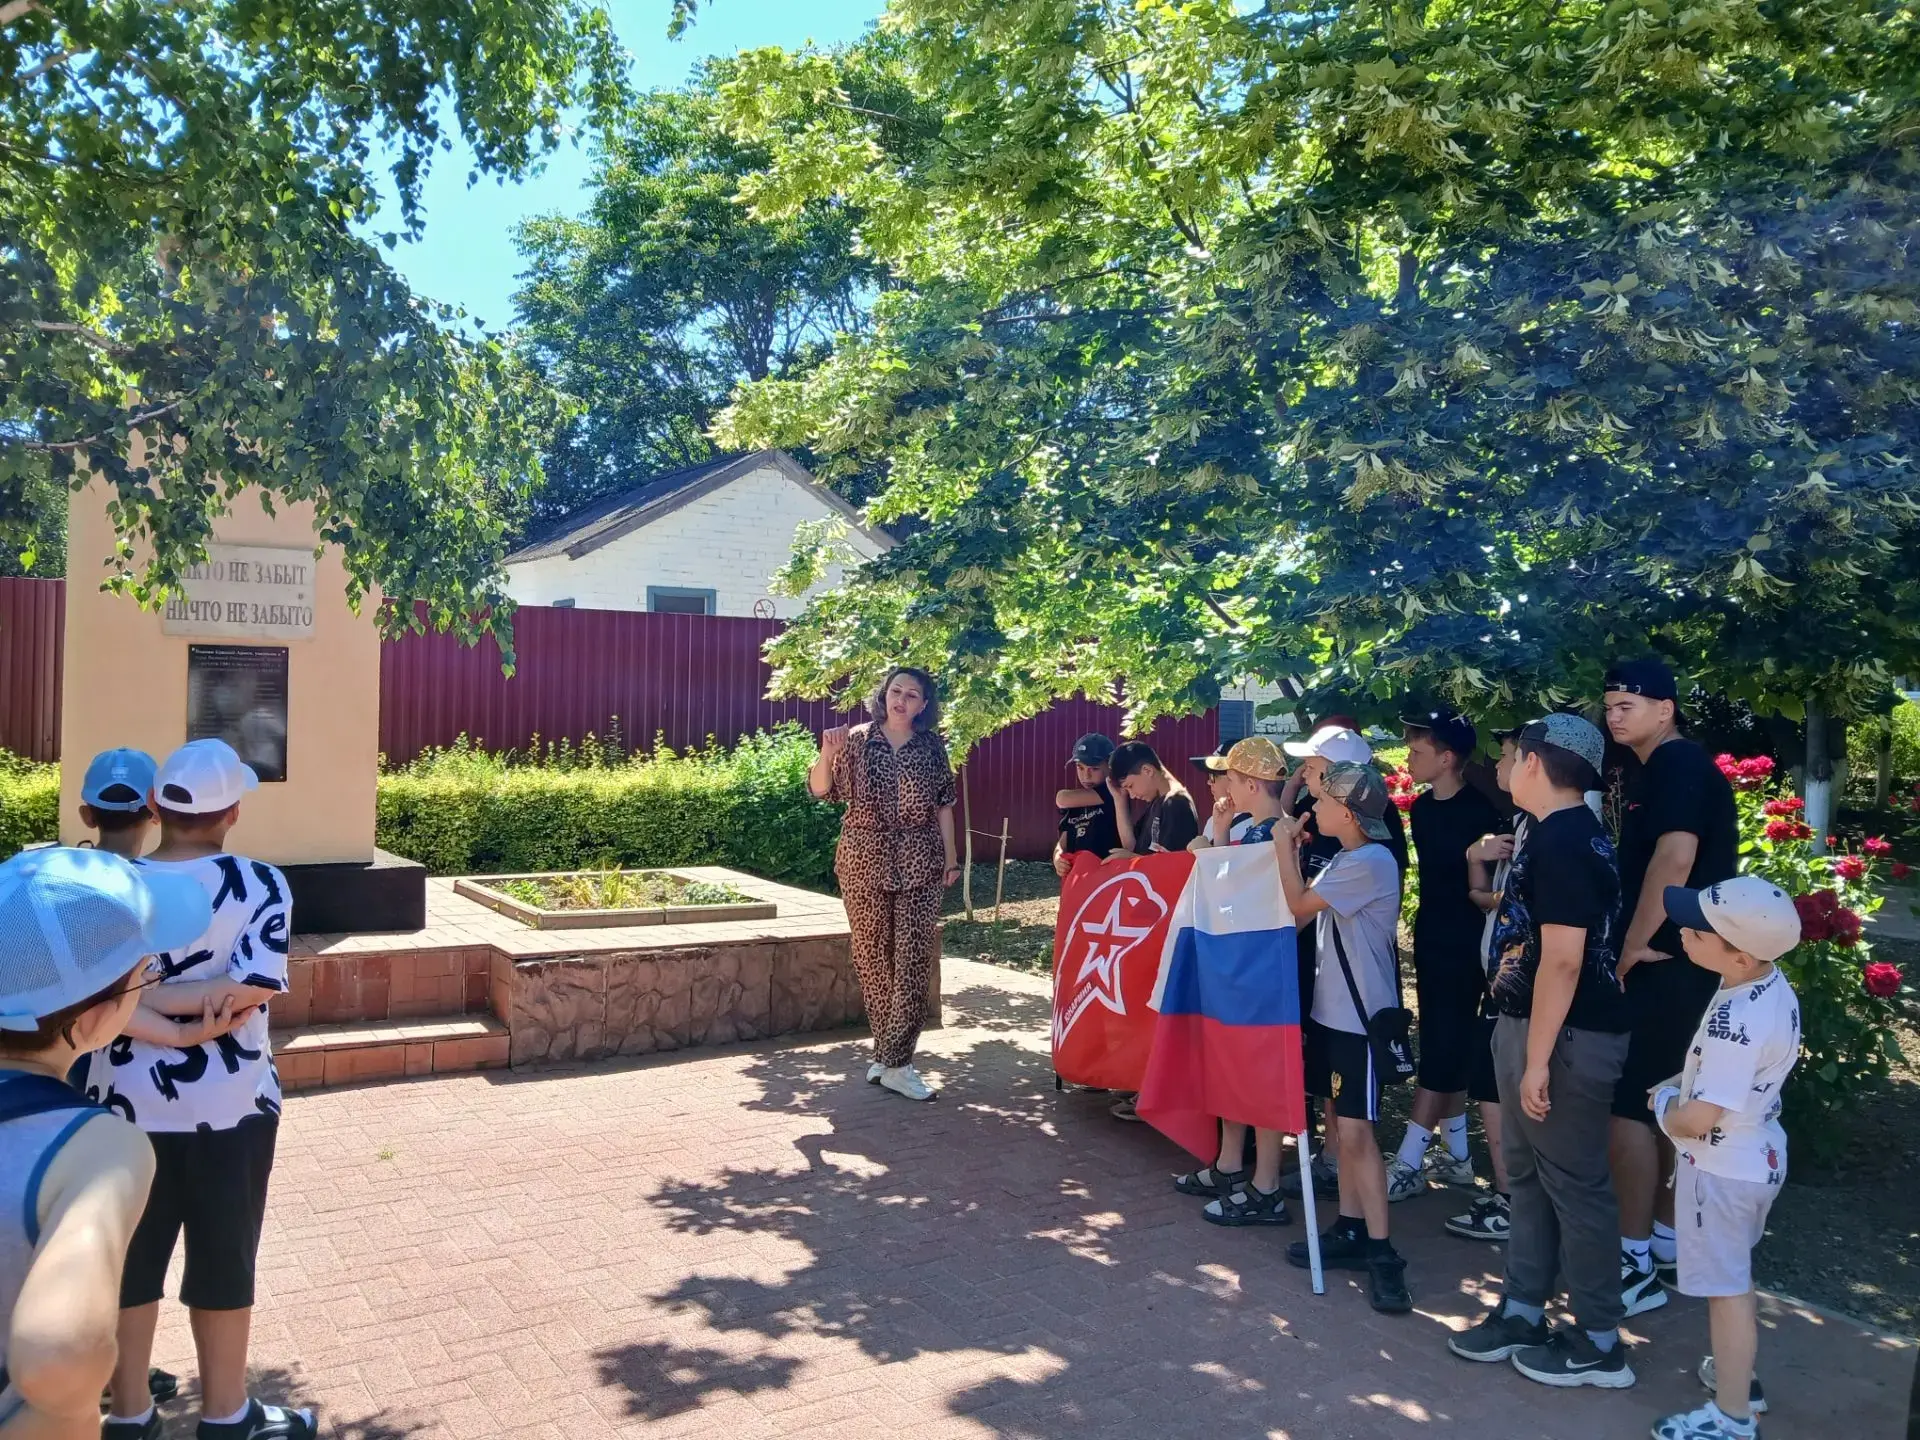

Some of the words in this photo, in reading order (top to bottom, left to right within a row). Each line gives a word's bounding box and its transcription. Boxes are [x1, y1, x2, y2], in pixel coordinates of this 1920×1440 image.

[229, 561, 249, 583] НЕ
[254, 564, 307, 585] ЗАБЫТ
[165, 599, 222, 622] НИЧТО
[225, 602, 248, 623] НЕ
[251, 603, 313, 627] ЗАБЫТО
[1064, 982, 1092, 1023] ЮНАРМИЯ
[1396, 1062, 1413, 1073] adidas
